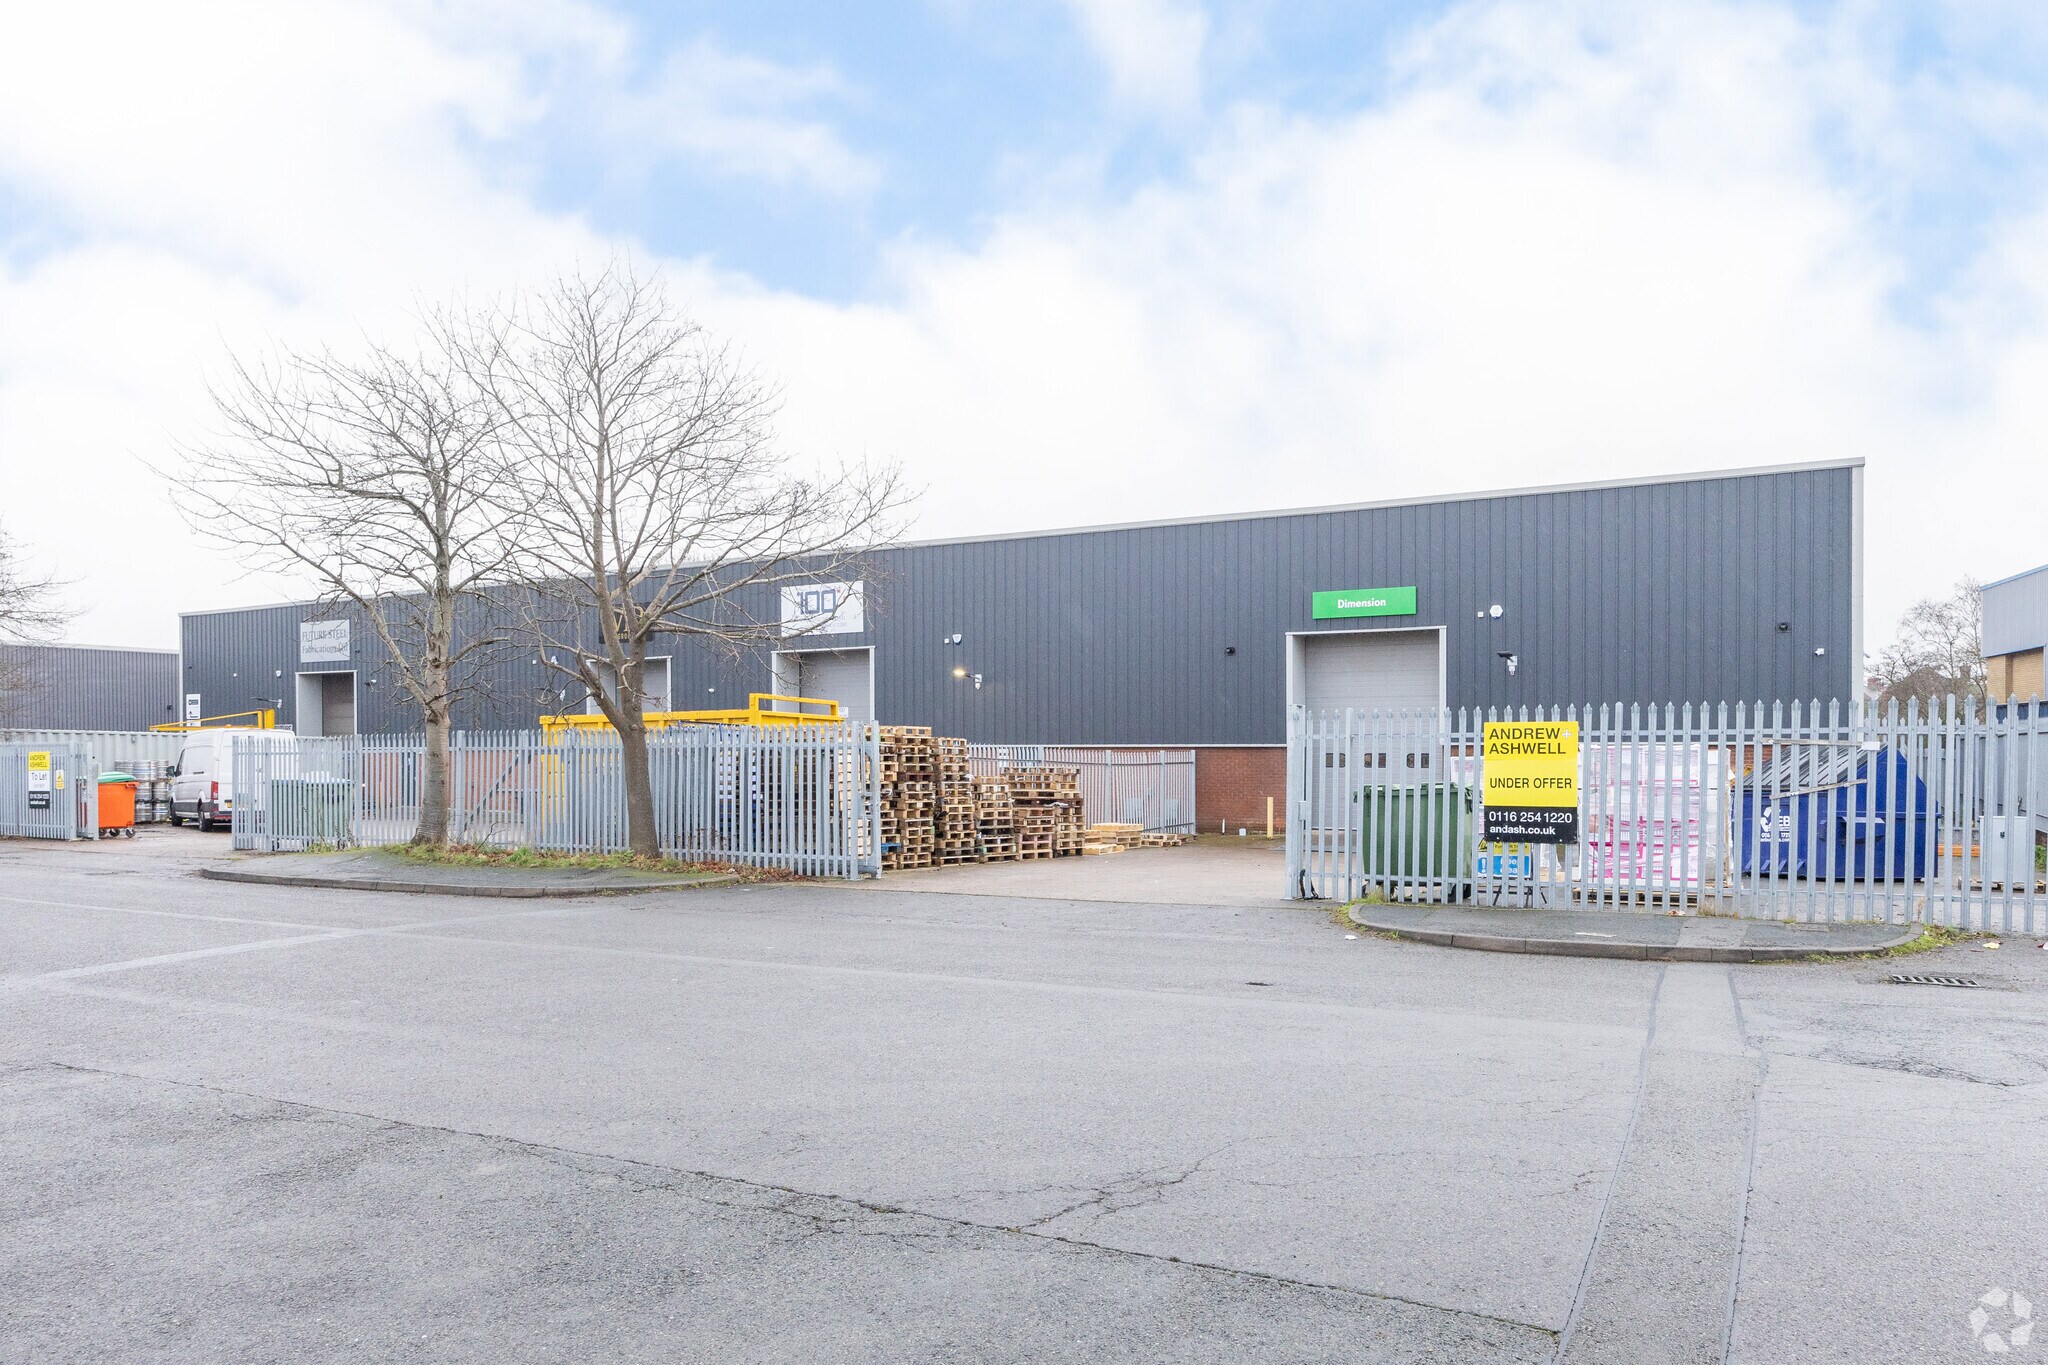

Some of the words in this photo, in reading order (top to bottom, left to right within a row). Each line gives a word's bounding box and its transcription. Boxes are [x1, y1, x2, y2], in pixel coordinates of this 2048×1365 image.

[1337, 597, 1387, 609] Dimension
[1489, 742, 1567, 755] ASHWELL
[1489, 777, 1530, 789] UNDER
[1533, 777, 1573, 789] OFFER
[1488, 811, 1518, 822] 0116
[1520, 812, 1542, 823] 254
[1544, 812, 1573, 824] 1220
[1489, 825, 1556, 836] andash.co.uk
